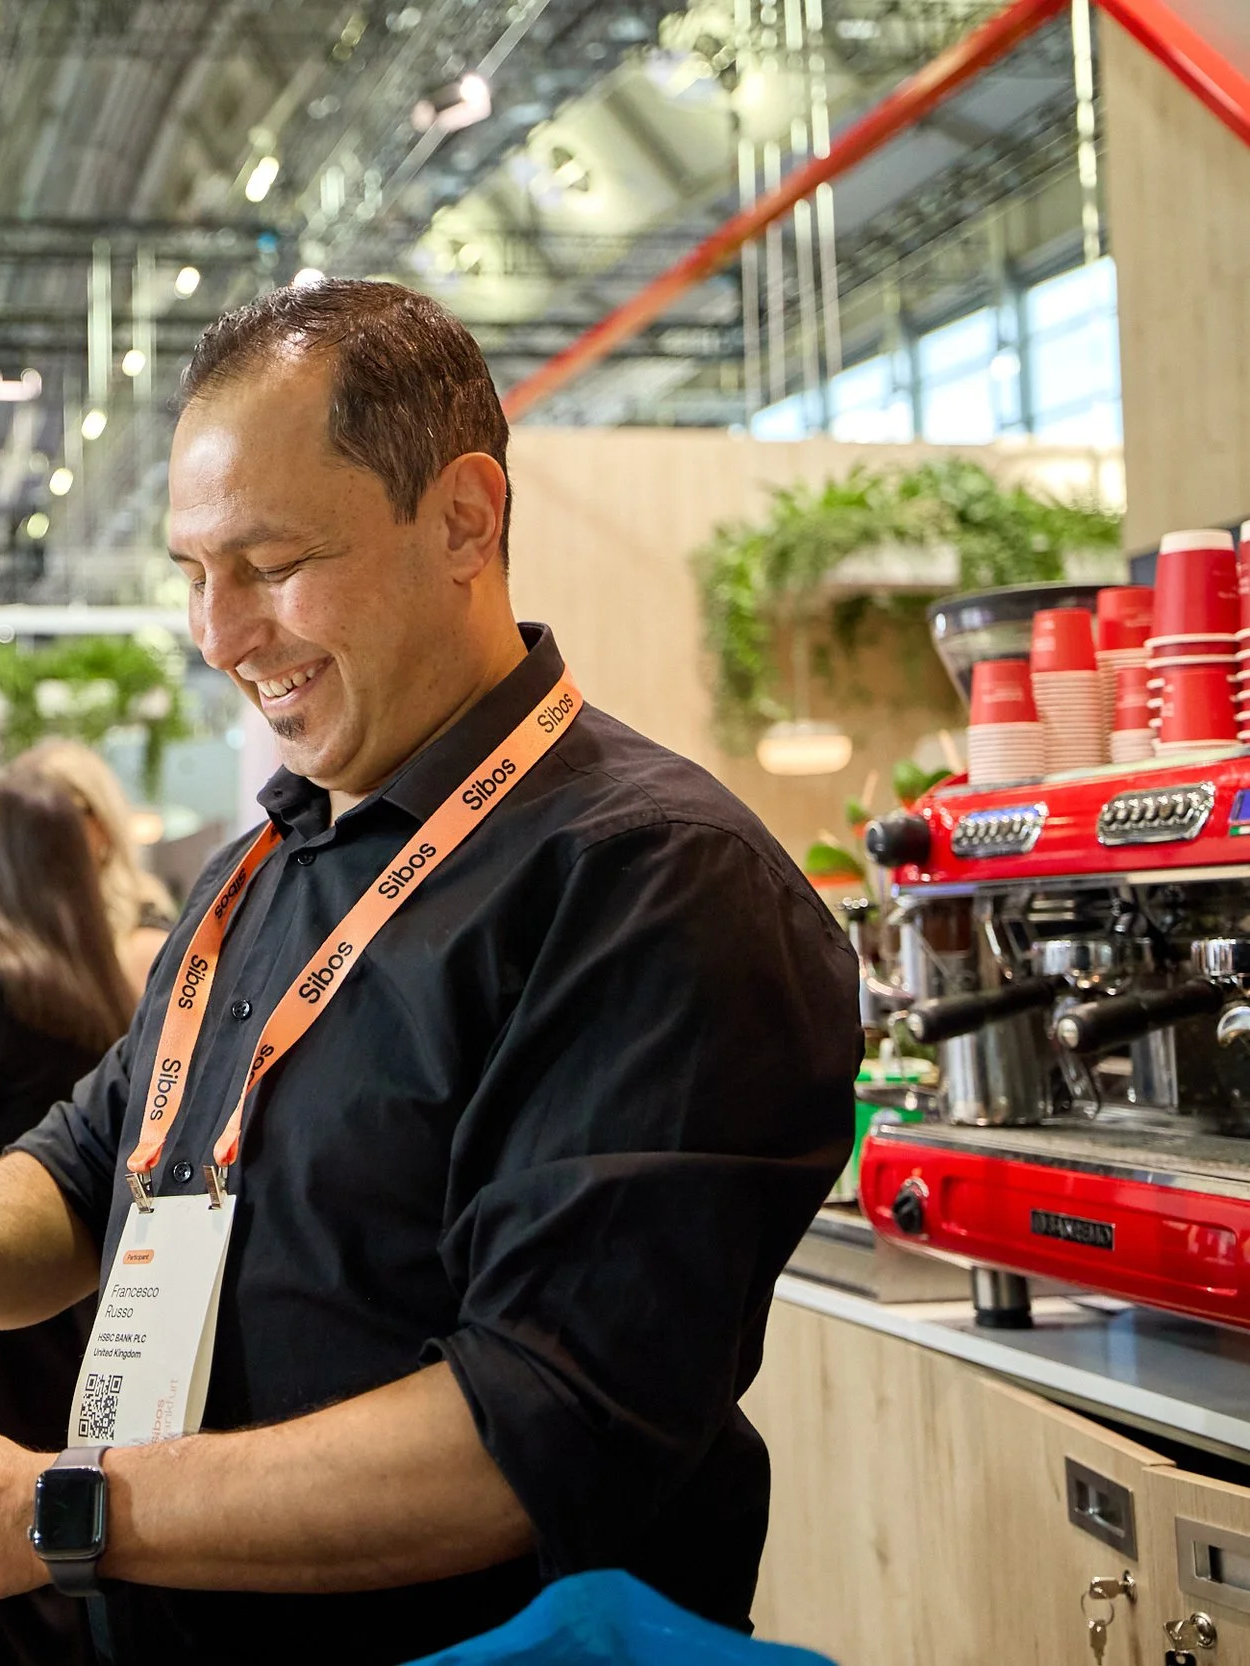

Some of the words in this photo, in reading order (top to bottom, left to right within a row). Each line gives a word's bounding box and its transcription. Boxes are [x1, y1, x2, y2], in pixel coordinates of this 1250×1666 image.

[537, 693, 574, 734] Sibos
[462, 757, 517, 812] Sibos
[214, 867, 247, 919] Sibos
[378, 842, 437, 900] Sibos
[178, 954, 209, 1010] Sibos
[299, 941, 354, 1005] Sibos
[150, 1057, 182, 1121] Sibos
[105, 1304, 134, 1318] Russo
[111, 1284, 160, 1298] Francesco
[93, 1348, 113, 1358] United
[113, 1349, 142, 1360] Kingdom
[97, 1333, 115, 1342] HSBC
[115, 1333, 133, 1343] BANK
[133, 1334, 147, 1343] PLC
